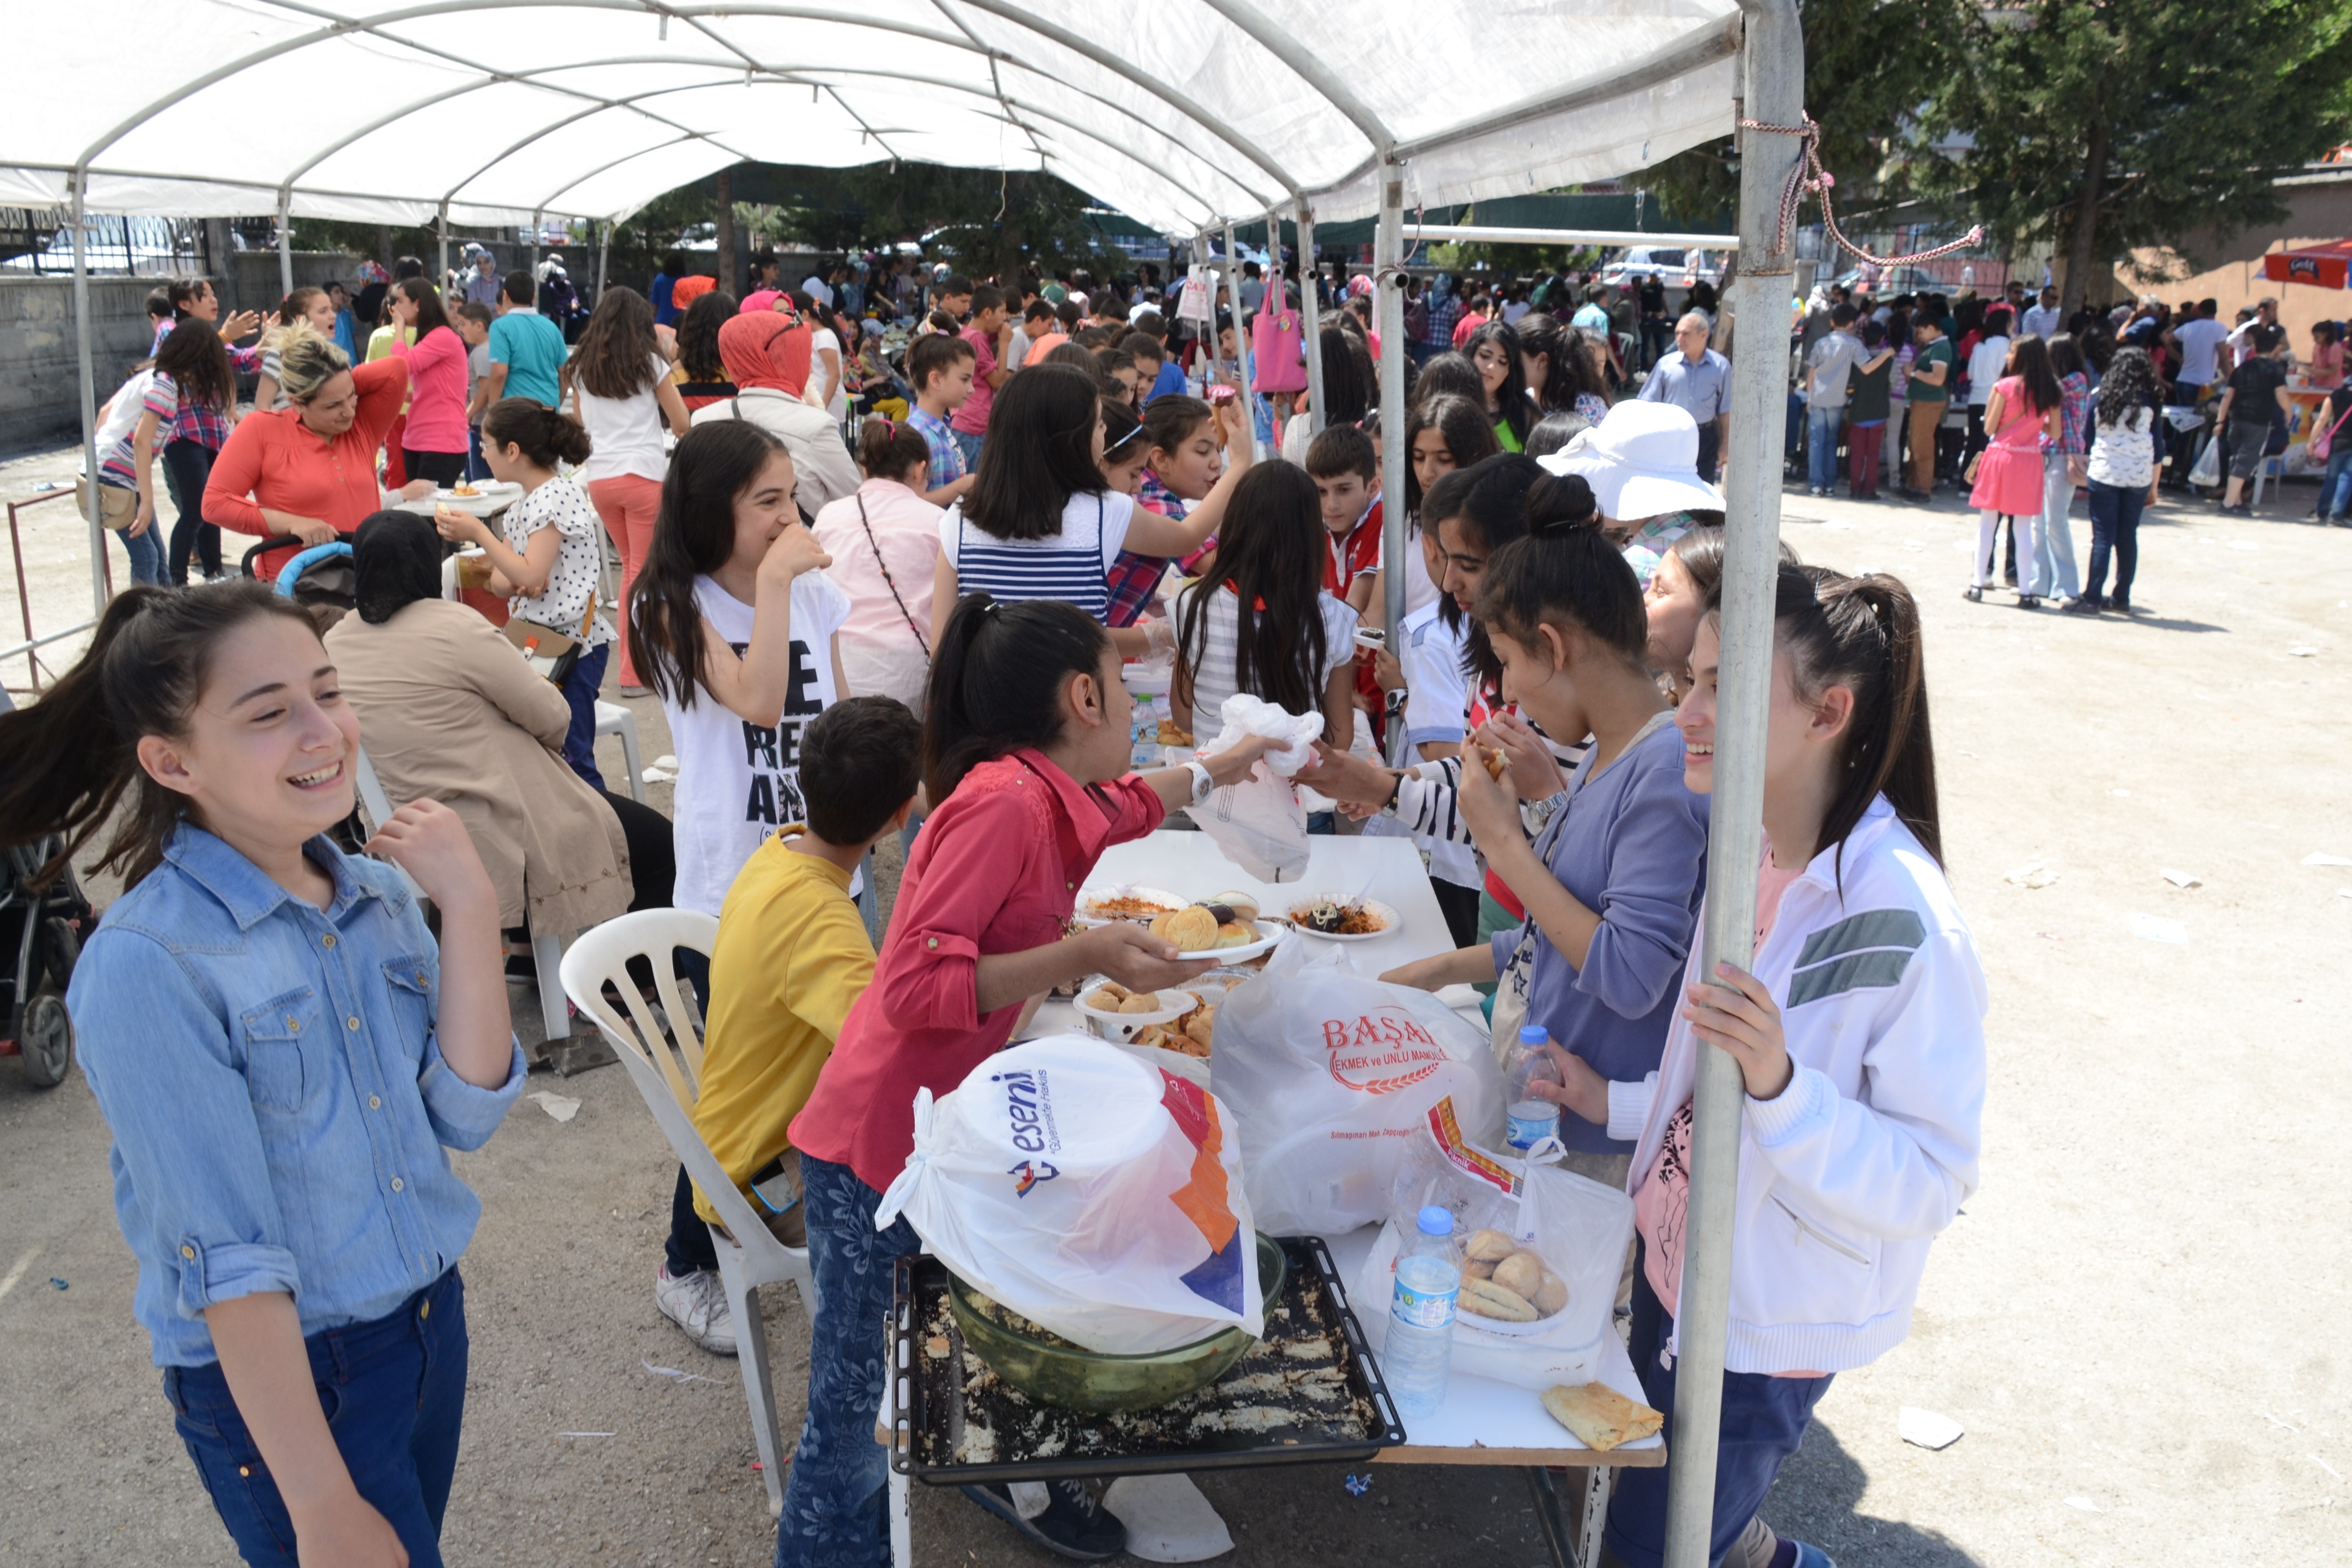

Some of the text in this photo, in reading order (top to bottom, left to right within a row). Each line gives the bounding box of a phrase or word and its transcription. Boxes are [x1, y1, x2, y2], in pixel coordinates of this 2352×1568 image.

[1334, 1056, 1369, 1071] EKMEK
[1370, 1058, 1382, 1066] ve
[1383, 1050, 1409, 1065] UNLU
[1448, 1148, 1471, 1171] Piknik
